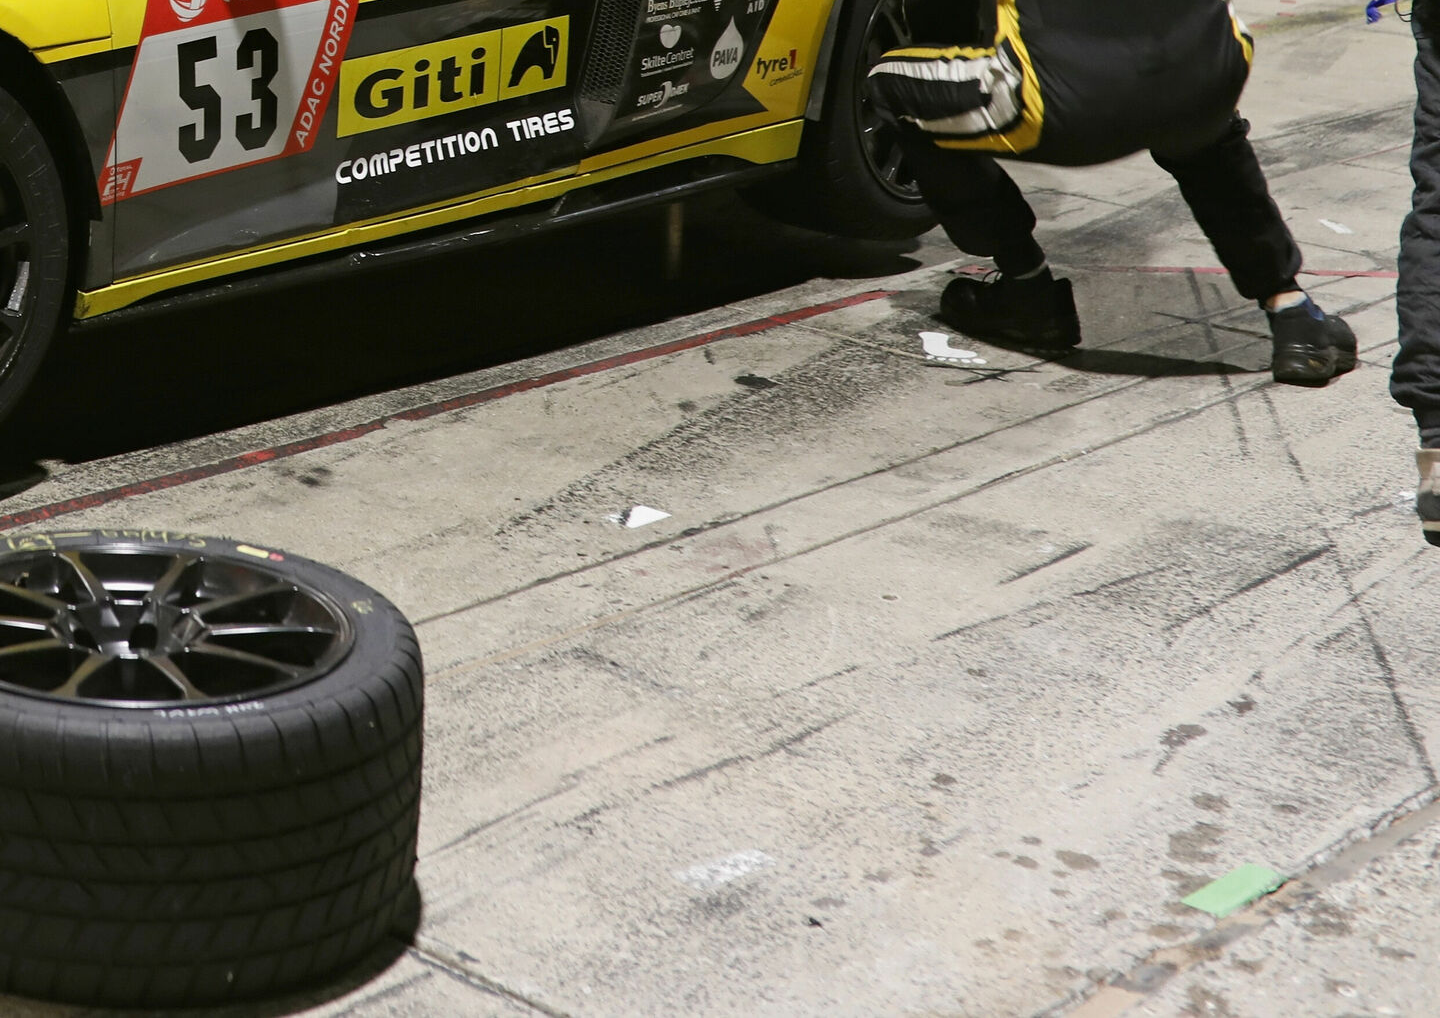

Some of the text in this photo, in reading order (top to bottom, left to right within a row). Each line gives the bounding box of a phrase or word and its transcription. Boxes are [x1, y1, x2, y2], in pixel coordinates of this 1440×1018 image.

[746, 0, 765, 15] AID
[354, 47, 487, 119] Giti
[712, 47, 739, 68] PAVA
[756, 49, 797, 80] tyre1
[177, 27, 279, 164] 53
[295, 77, 326, 149] ADAC
[335, 108, 575, 185] COMPETITION TIRES
